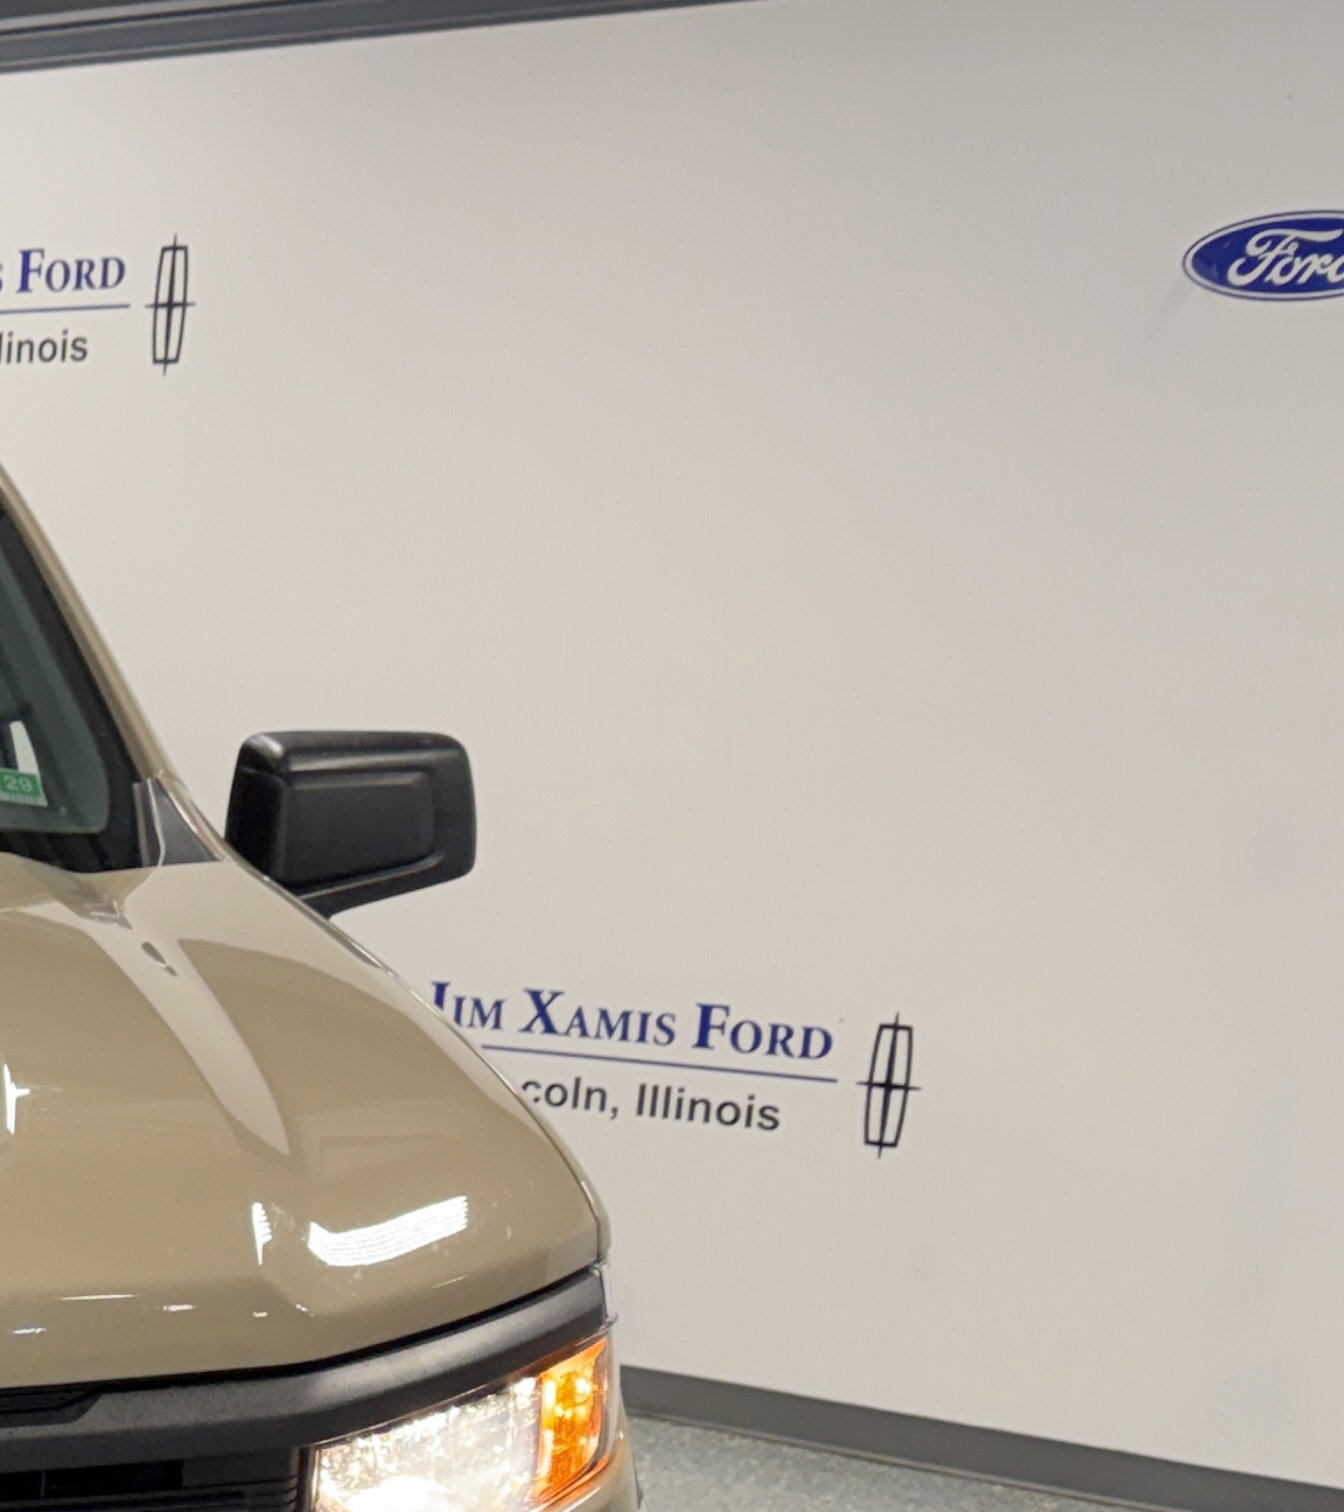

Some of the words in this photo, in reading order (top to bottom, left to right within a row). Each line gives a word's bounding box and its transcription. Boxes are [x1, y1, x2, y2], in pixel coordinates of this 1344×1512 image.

[16, 248, 126, 294] FORD
[518, 988, 676, 1047] XAMIS
[691, 1002, 832, 1061] FORD
[635, 1083, 780, 1131] Illinois
